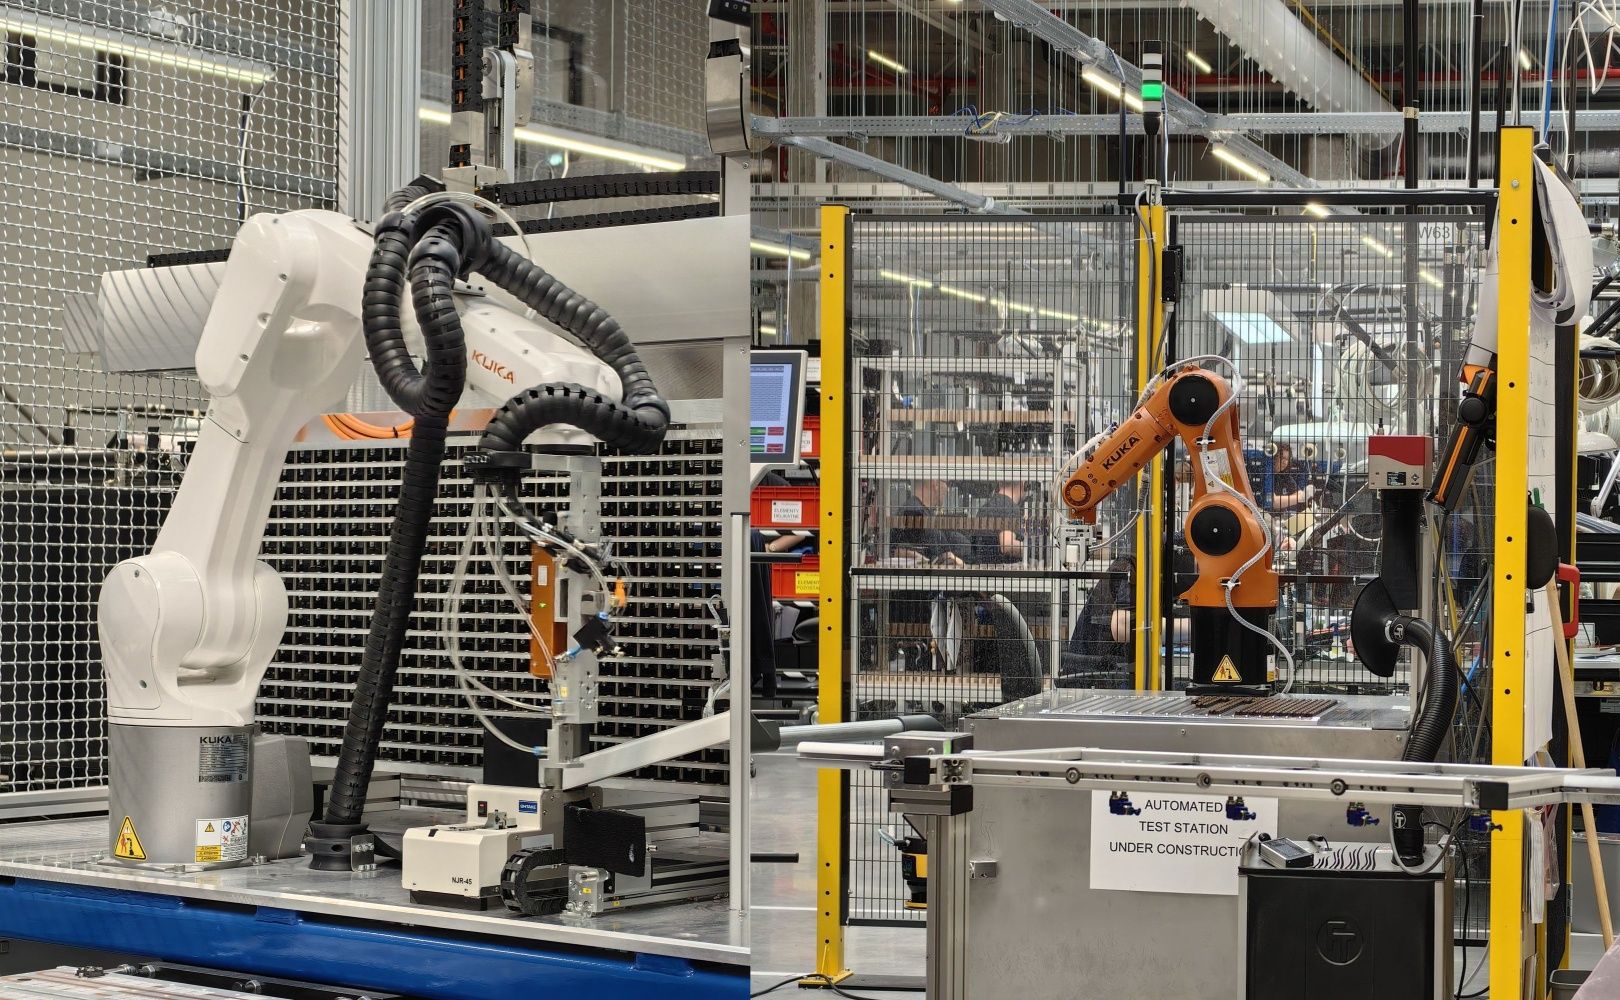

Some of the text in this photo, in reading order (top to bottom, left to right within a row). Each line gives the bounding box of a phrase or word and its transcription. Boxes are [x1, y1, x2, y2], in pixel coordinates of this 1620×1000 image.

[472, 349, 514, 384] KUKA
[1102, 436, 1141, 470] KUKA
[199, 736, 232, 744] KUKA
[1144, 799, 1223, 813] AUTOMATED
[1139, 820, 1229, 835] TEST STATION
[1109, 841, 1153, 854] UNDER
[451, 877, 473, 885] NJR-45
